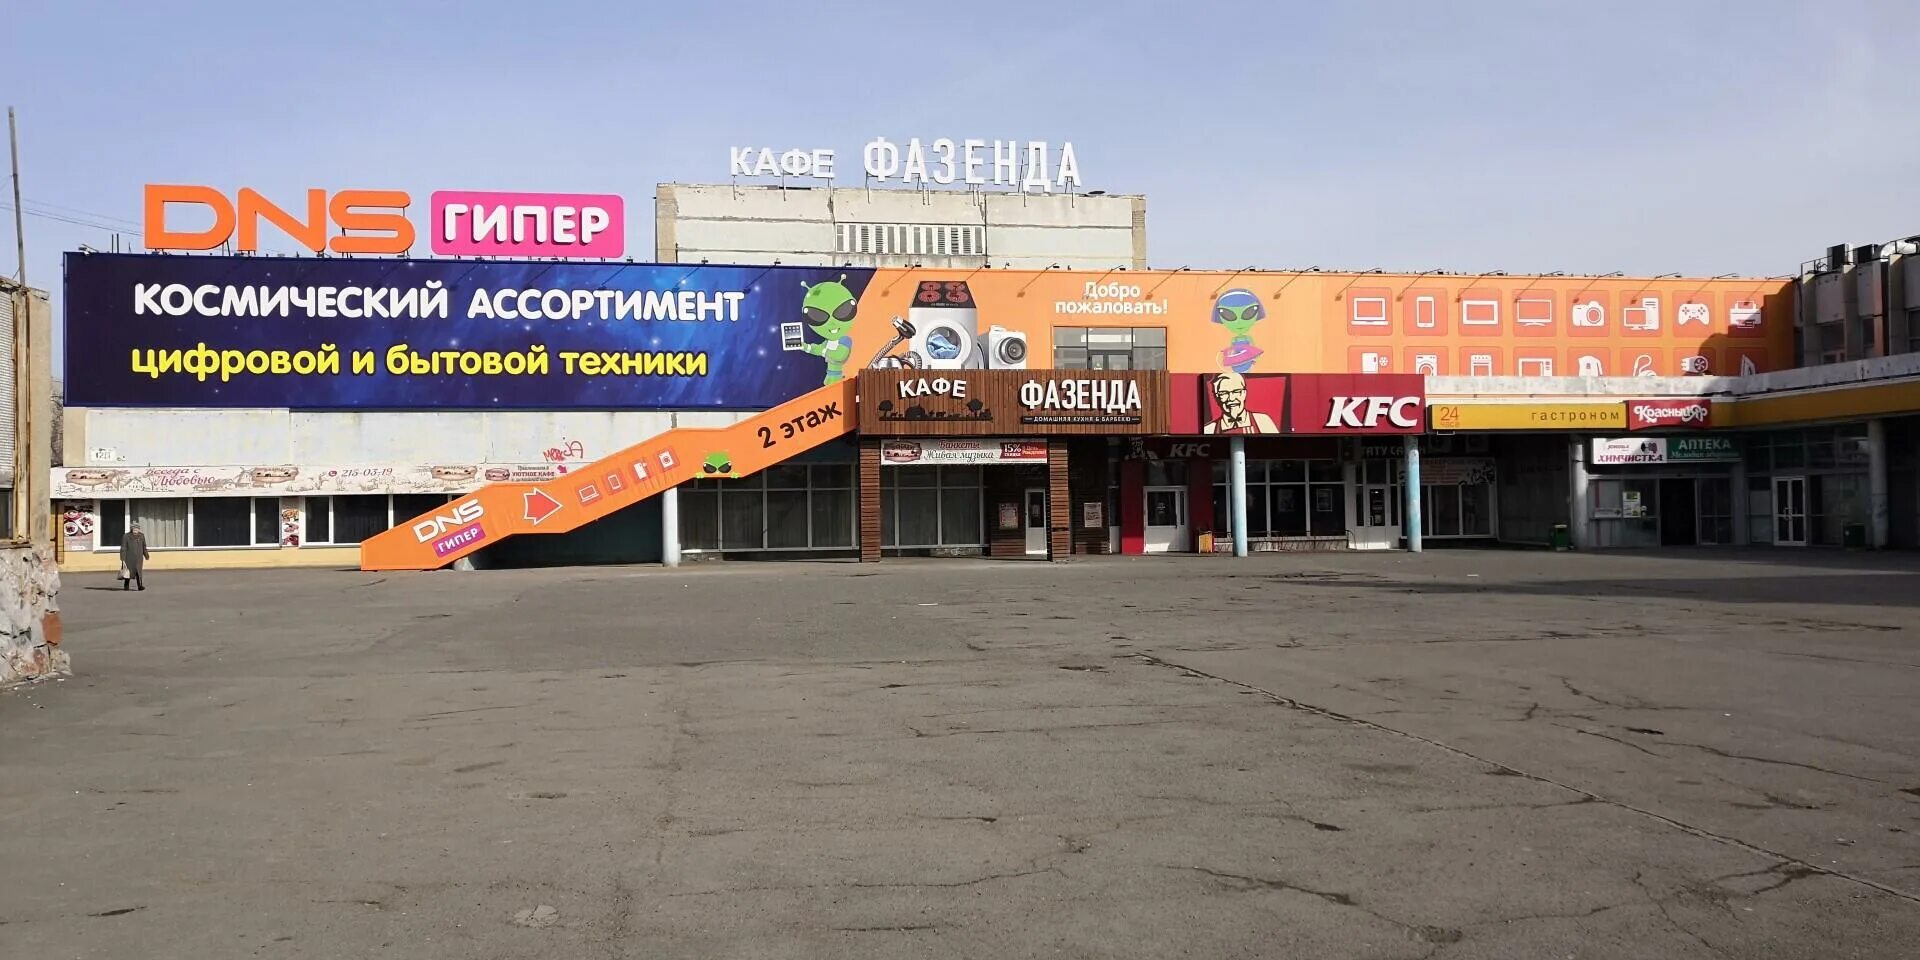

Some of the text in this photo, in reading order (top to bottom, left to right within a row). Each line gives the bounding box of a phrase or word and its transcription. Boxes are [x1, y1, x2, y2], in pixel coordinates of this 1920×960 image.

[730, 137, 1082, 192] КАФЕ ФАЗЕНДА
[144, 184, 416, 254] DNS
[443, 203, 610, 244] ГИПЕР
[133, 280, 744, 322] КОСМИЧЕСКИЙ АССОРТИМЕНТ
[1083, 281, 1140, 301] Добро
[1055, 299, 1168, 314] пожаловать!
[131, 343, 708, 382] цифровой и бытовой техники
[899, 376, 967, 398] КАФЕ
[1020, 379, 1141, 413] ФАЗЕНДА
[1325, 396, 1421, 427] KFC
[1440, 406, 1458, 420] 24
[1531, 410, 1620, 422] гастроном
[757, 401, 842, 448] 2 этаж
[938, 439, 980, 449] Банкеты
[1004, 444, 1021, 453] 15%
[1169, 443, 1211, 458] KFC
[1678, 440, 1731, 450] АПТЕКА
[923, 450, 994, 462] Живая музыка
[1598, 454, 1663, 463] ХИМЧИСТКА
[412, 498, 484, 543] DNS
[437, 527, 479, 553] ГИПЕР
